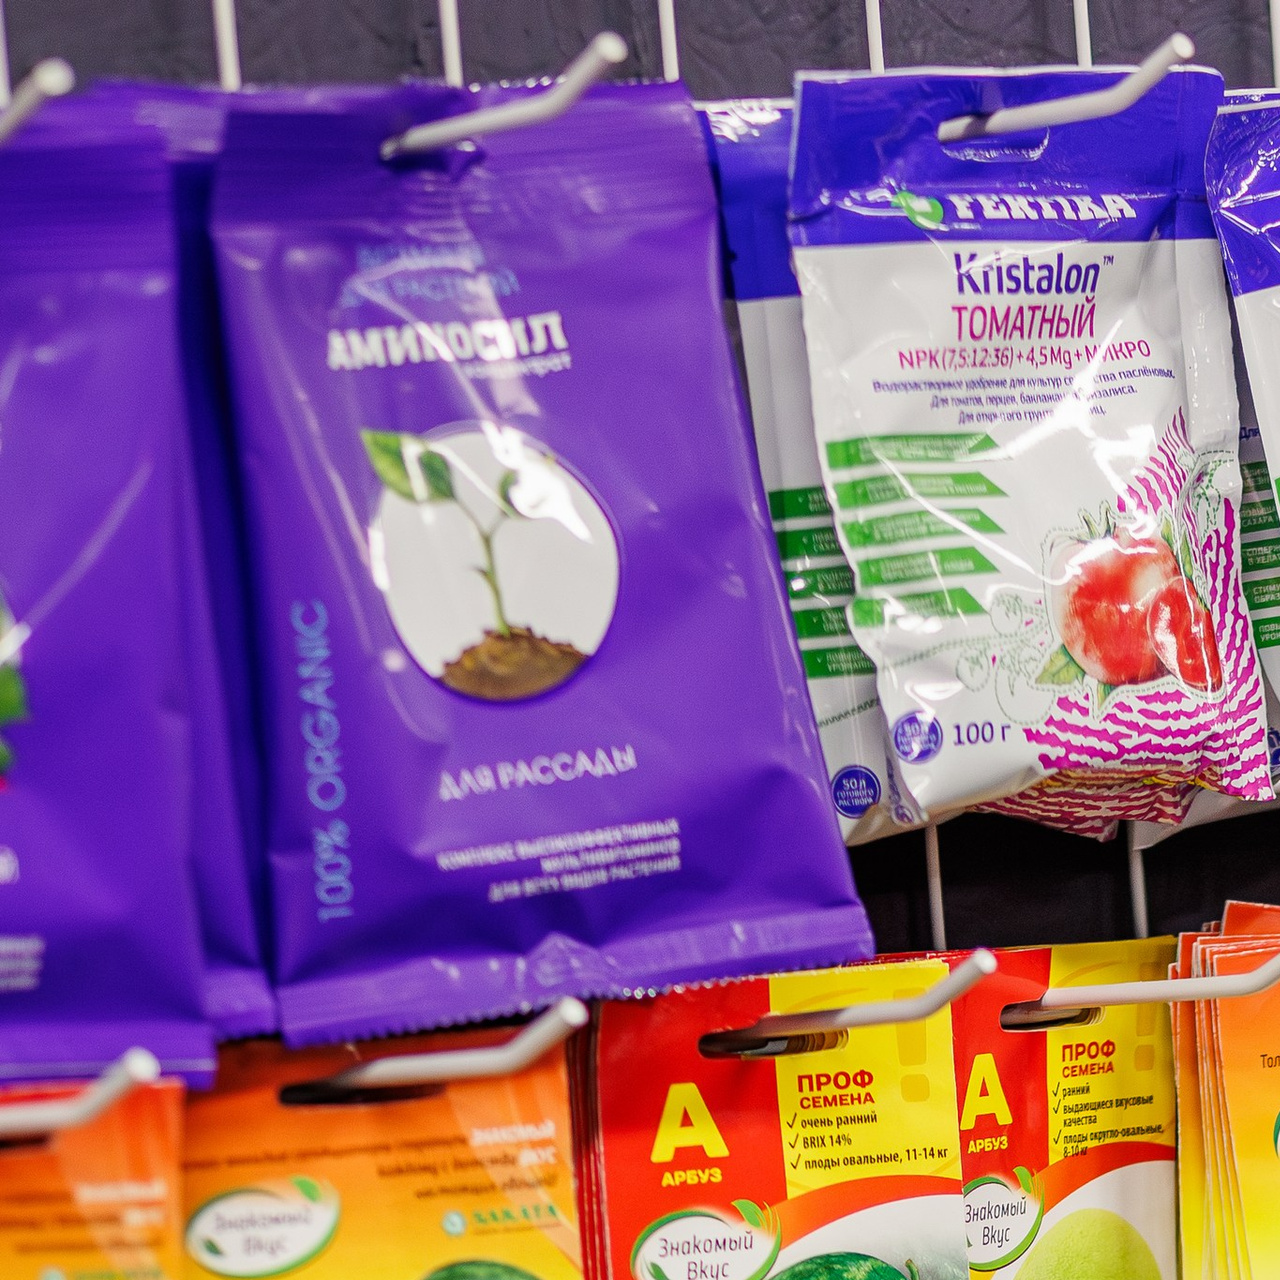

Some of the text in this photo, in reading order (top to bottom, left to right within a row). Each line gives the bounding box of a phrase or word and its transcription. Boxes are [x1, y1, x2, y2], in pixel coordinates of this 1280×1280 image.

[951, 295, 1097, 343] ТОМАТНЫЙ
[952, 722, 998, 746] 100
[288, 600, 353, 925] 100% ORGANIC
[438, 743, 638, 802] ДЛЯ РАССАДЫ
[1061, 1038, 1117, 1063] ПРОФ
[796, 1068, 875, 1094] ПРОФ
[1061, 1060, 1116, 1080] СЕМЕНА
[798, 1090, 876, 1112] СЕМЕНА
[959, 1052, 1014, 1132] А
[1062, 1081, 1092, 1099] ранний
[1062, 1098, 1115, 1116] выдающиеся
[650, 1081, 731, 1164] А
[800, 1111, 879, 1131] очень ранний
[1062, 1112, 1098, 1128] качества
[802, 1132, 854, 1150] BRIX 14%
[967, 1134, 1010, 1155] АРБУЗ
[804, 1146, 937, 1172] плоды овальные, 11-14
[660, 1166, 724, 1188] АРБУЗ
[964, 1195, 1028, 1225] Знакомый
[657, 1229, 755, 1259] Знакомый
[981, 1225, 1012, 1250] Вкус
